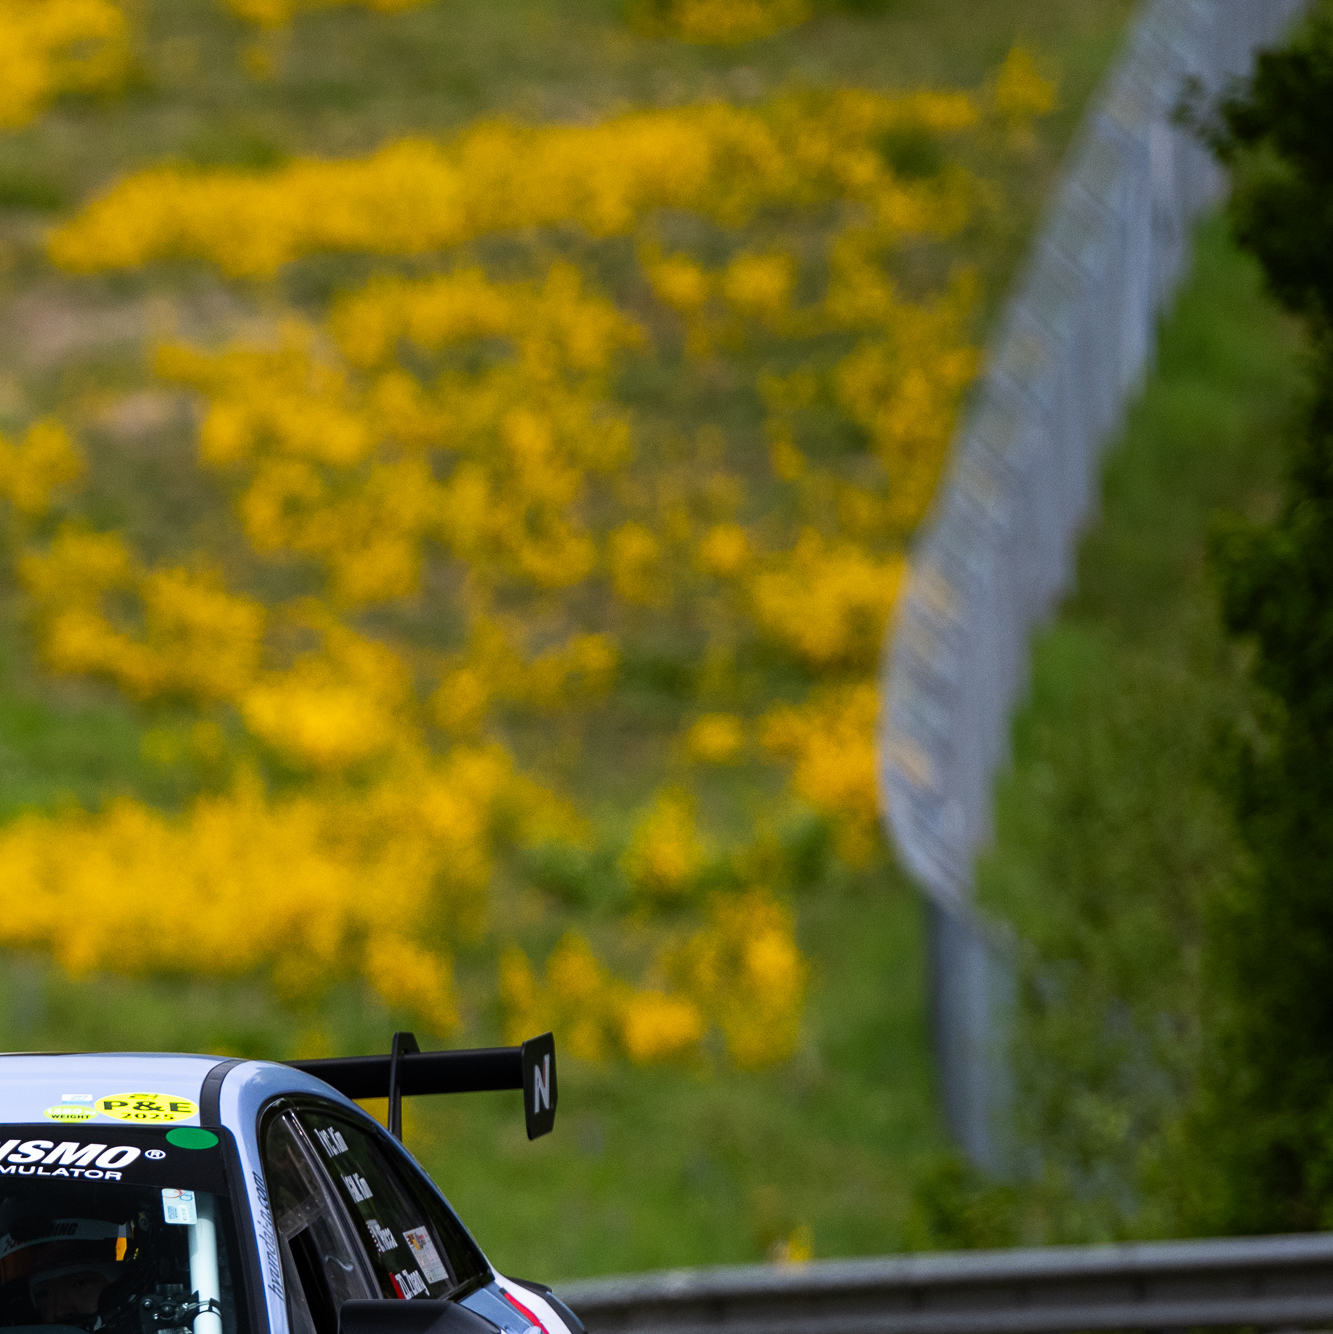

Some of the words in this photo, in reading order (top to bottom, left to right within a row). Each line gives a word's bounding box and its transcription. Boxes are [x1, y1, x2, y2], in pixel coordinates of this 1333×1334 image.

[534, 1053, 551, 1114] N
[102, 1100, 192, 1114] P&E
[121, 1112, 175, 1120] 2025
[251, 1170, 285, 1302] hyundai-n.com
